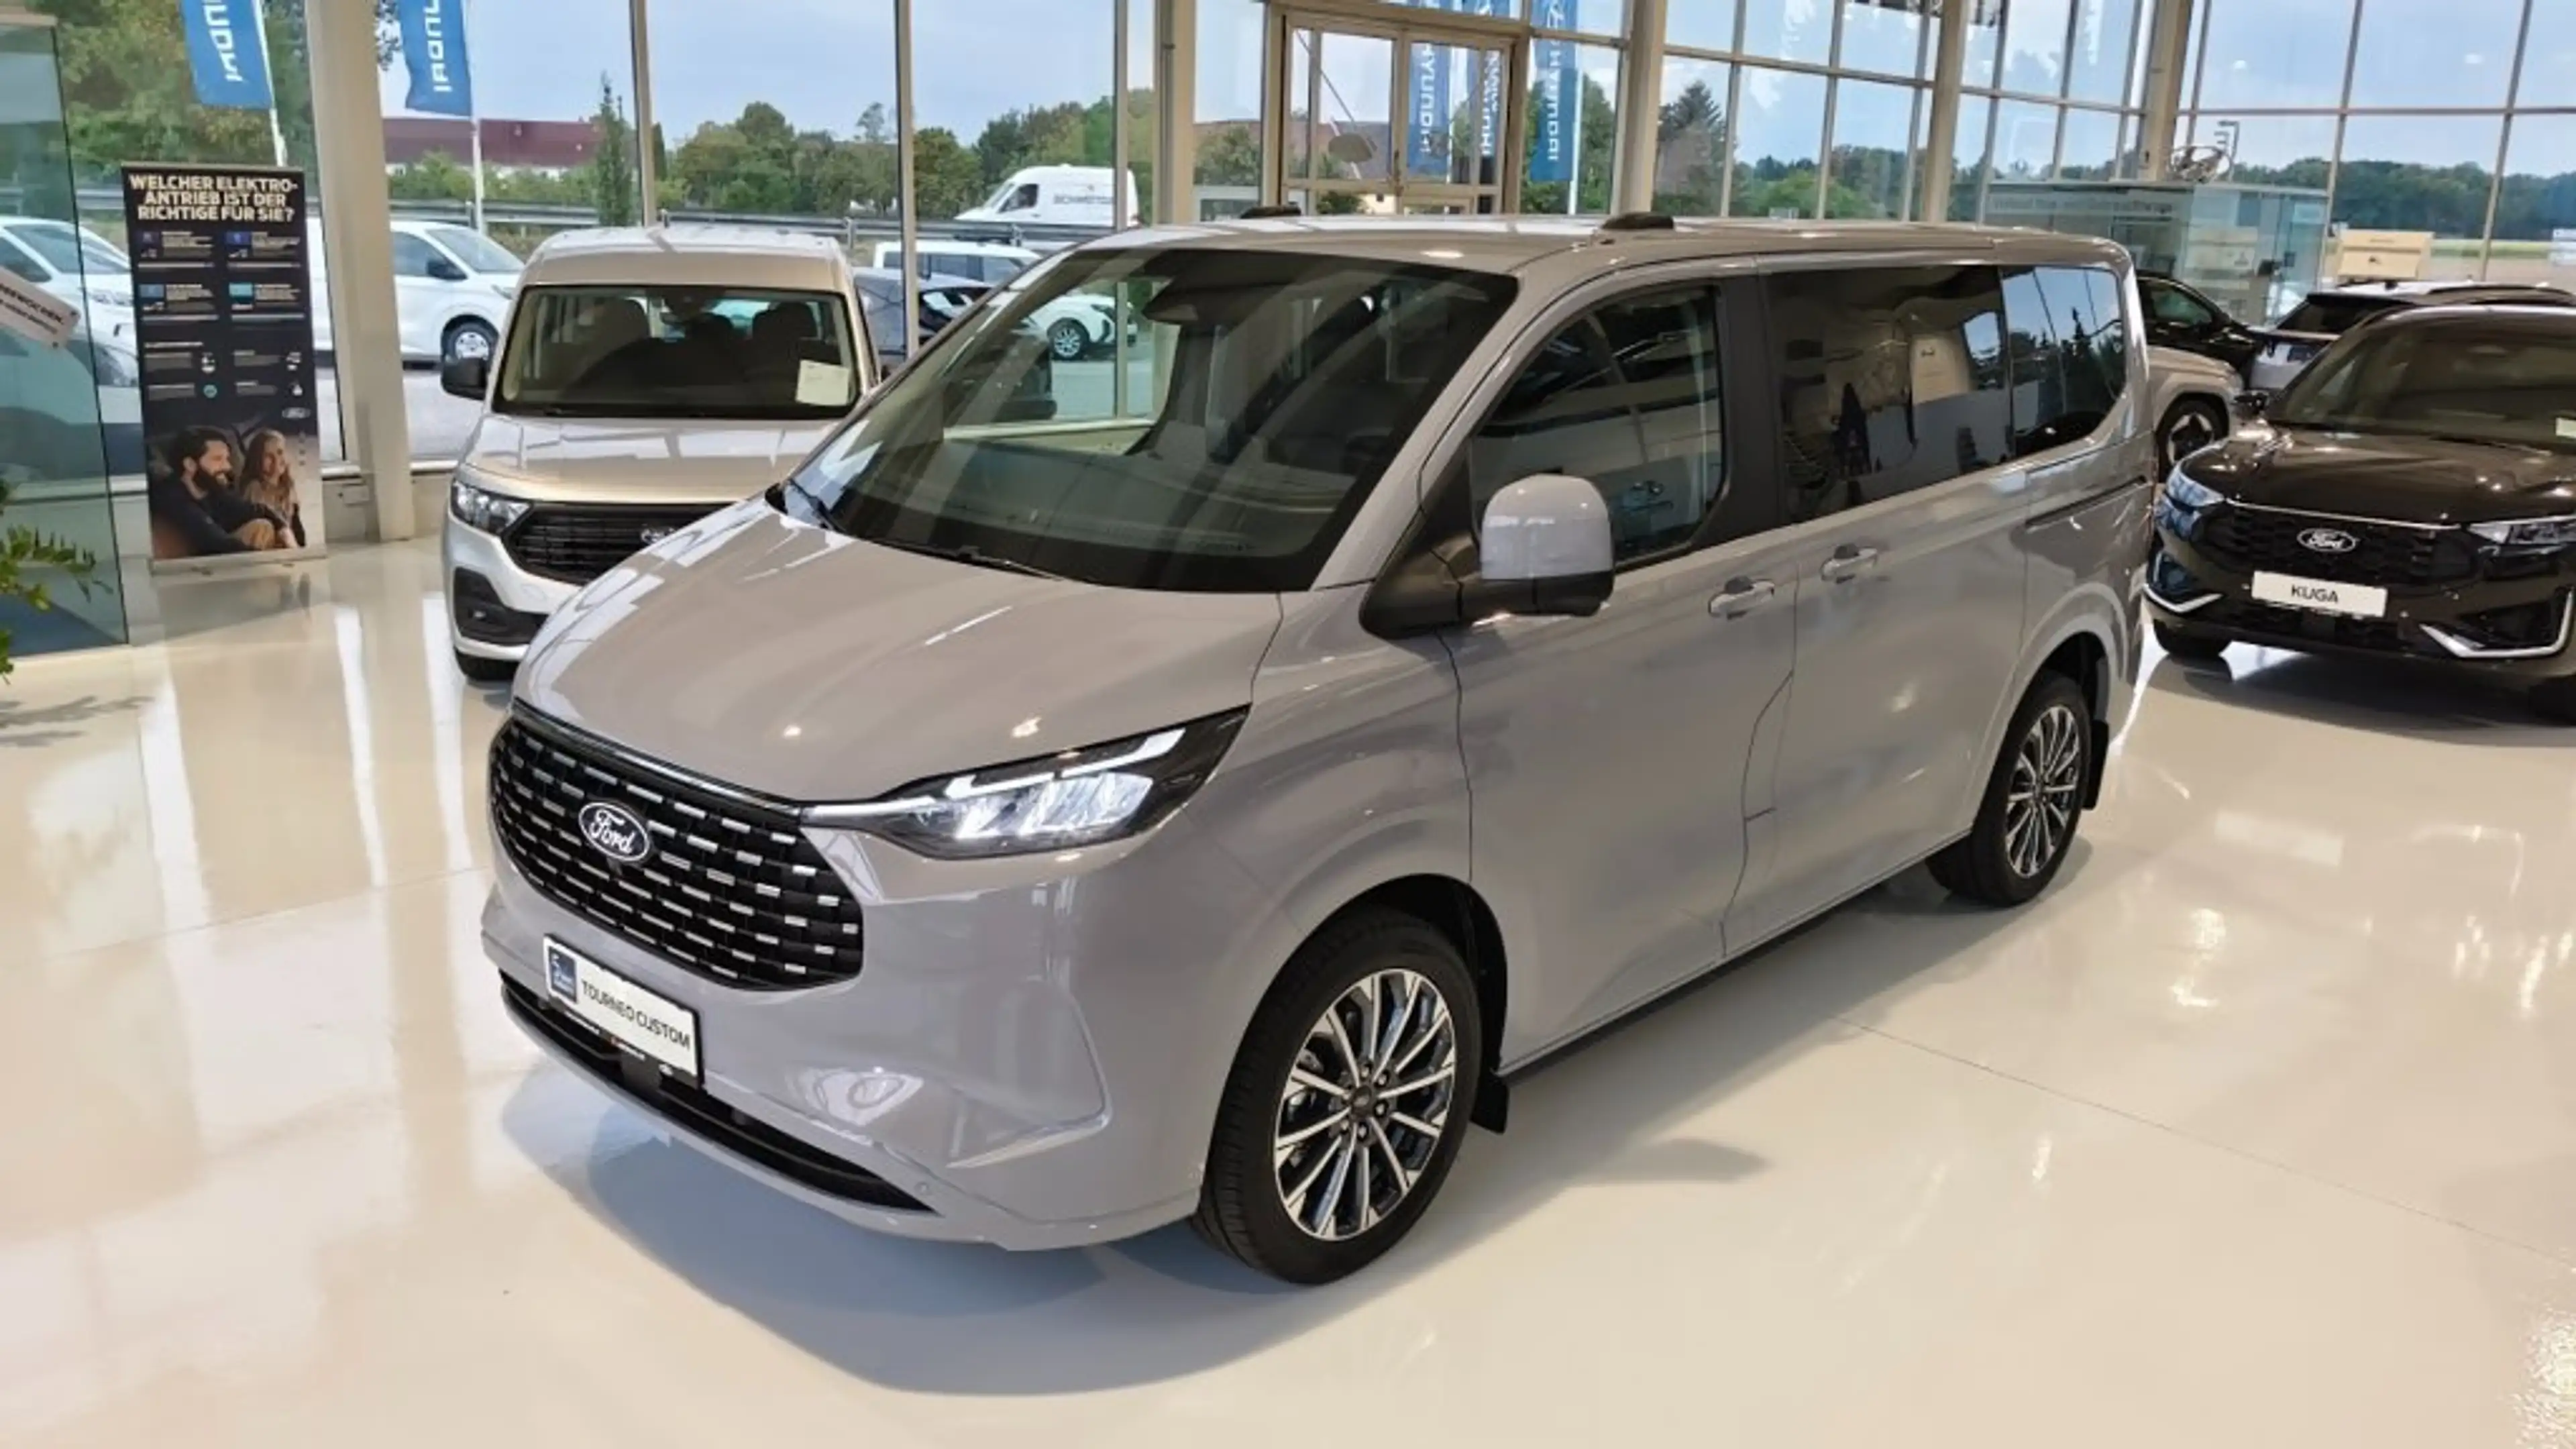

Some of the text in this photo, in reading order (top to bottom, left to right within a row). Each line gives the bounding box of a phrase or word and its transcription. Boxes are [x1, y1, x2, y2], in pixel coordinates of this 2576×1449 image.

[129, 174, 299, 192] WELCHER ELEKTRO-
[145, 191, 286, 207] ANTRIEB IST DER
[138, 205, 219, 221] RICHTIGE
[257, 208, 295, 223] SIE?
[2291, 584, 2338, 602] KUGA
[589, 810, 635, 854] Ford
[581, 979, 635, 1022] TOURNEO
[637, 1010, 690, 1051] CUSTOM
